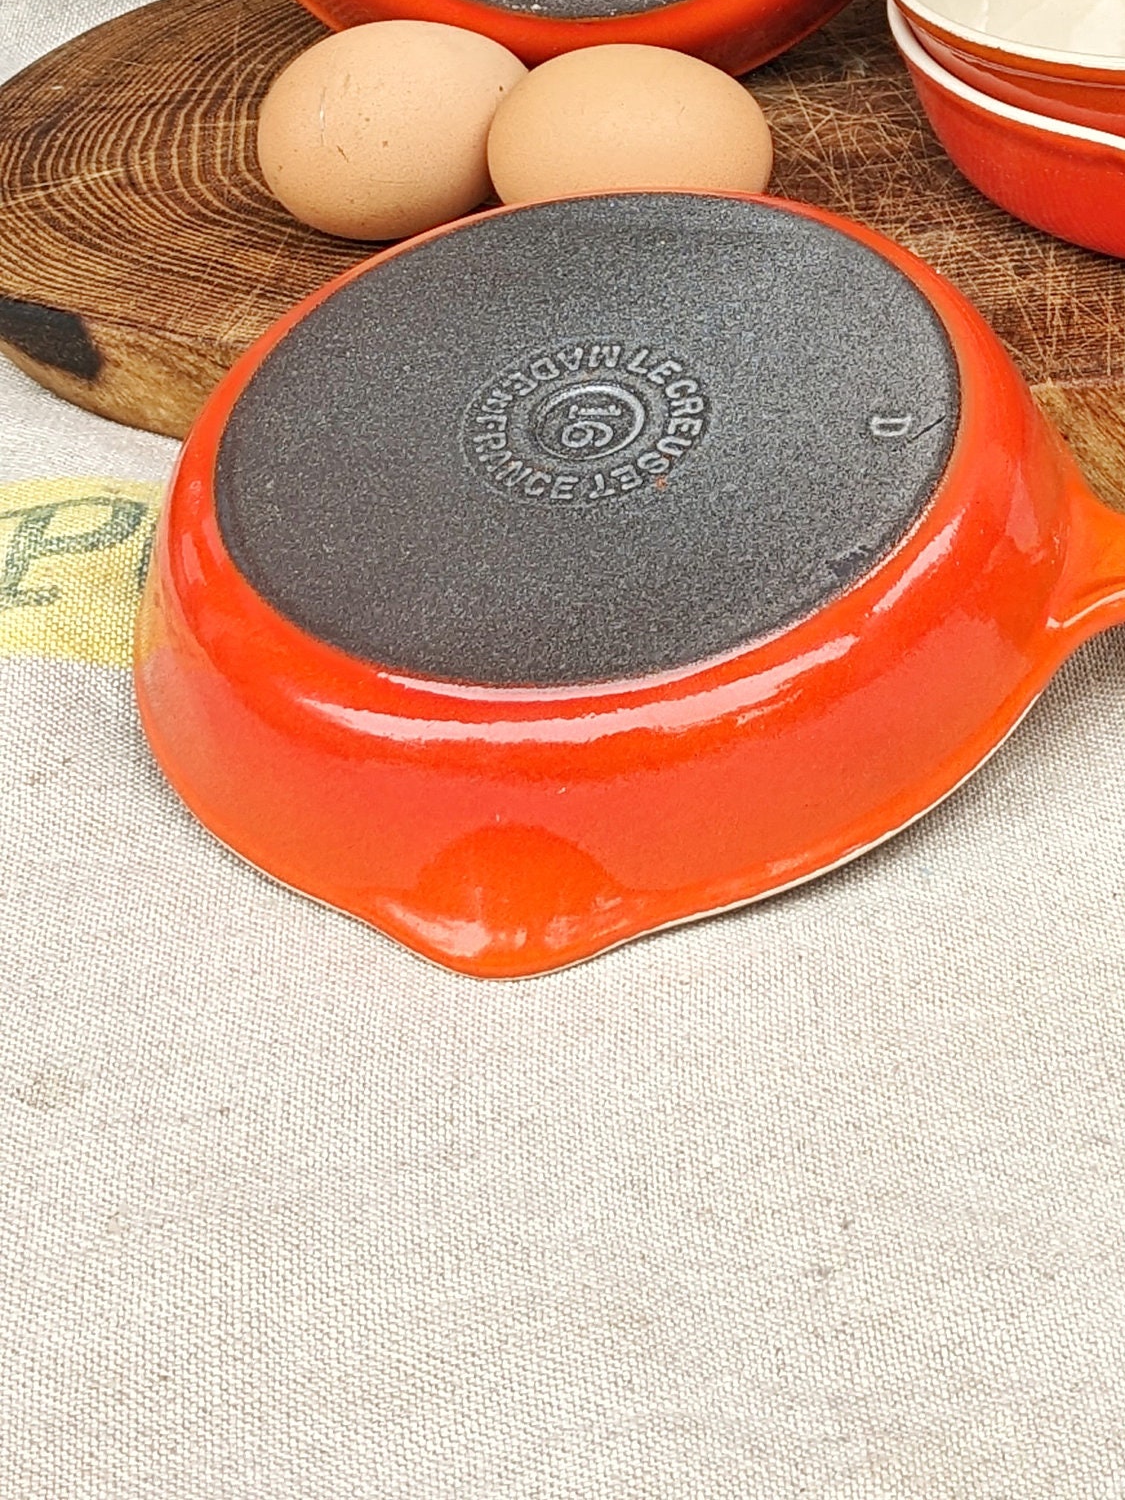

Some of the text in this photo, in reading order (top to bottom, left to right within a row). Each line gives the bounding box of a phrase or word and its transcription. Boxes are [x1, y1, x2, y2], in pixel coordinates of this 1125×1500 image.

[502, 345, 622, 397] MADE
[560, 404, 623, 449] 16
[588, 348, 706, 500] LE CREUSET
[869, 413, 912, 438] D
[472, 414, 580, 500] FRANCE
